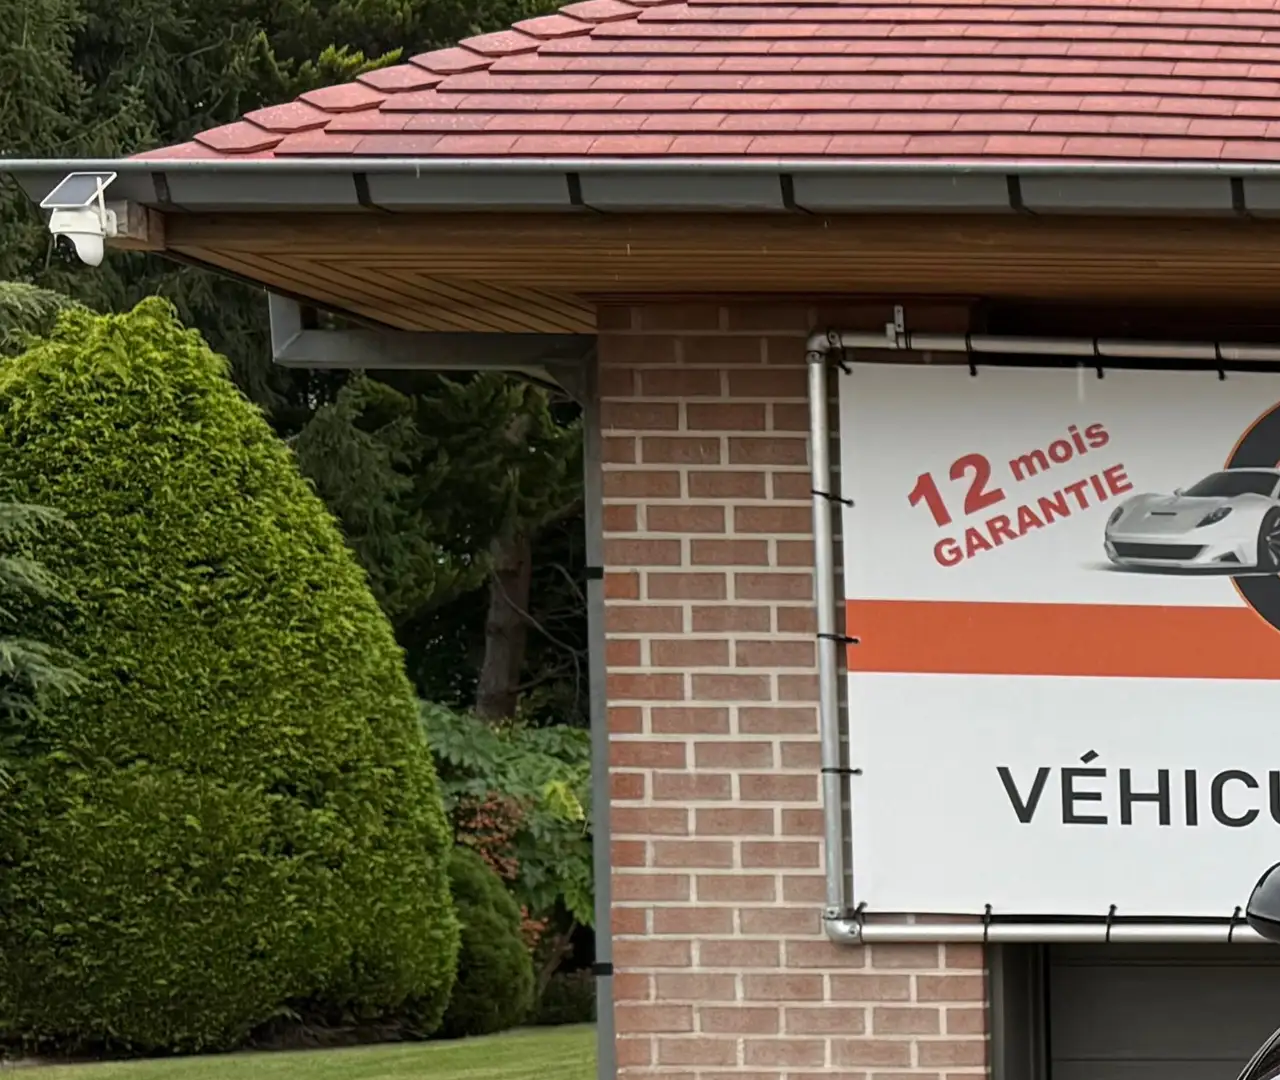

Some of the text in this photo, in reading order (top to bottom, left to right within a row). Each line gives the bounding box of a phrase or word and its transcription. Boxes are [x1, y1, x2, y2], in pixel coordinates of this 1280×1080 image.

[908, 424, 1109, 526] 12 mois
[933, 465, 1132, 567] GARANTIE
